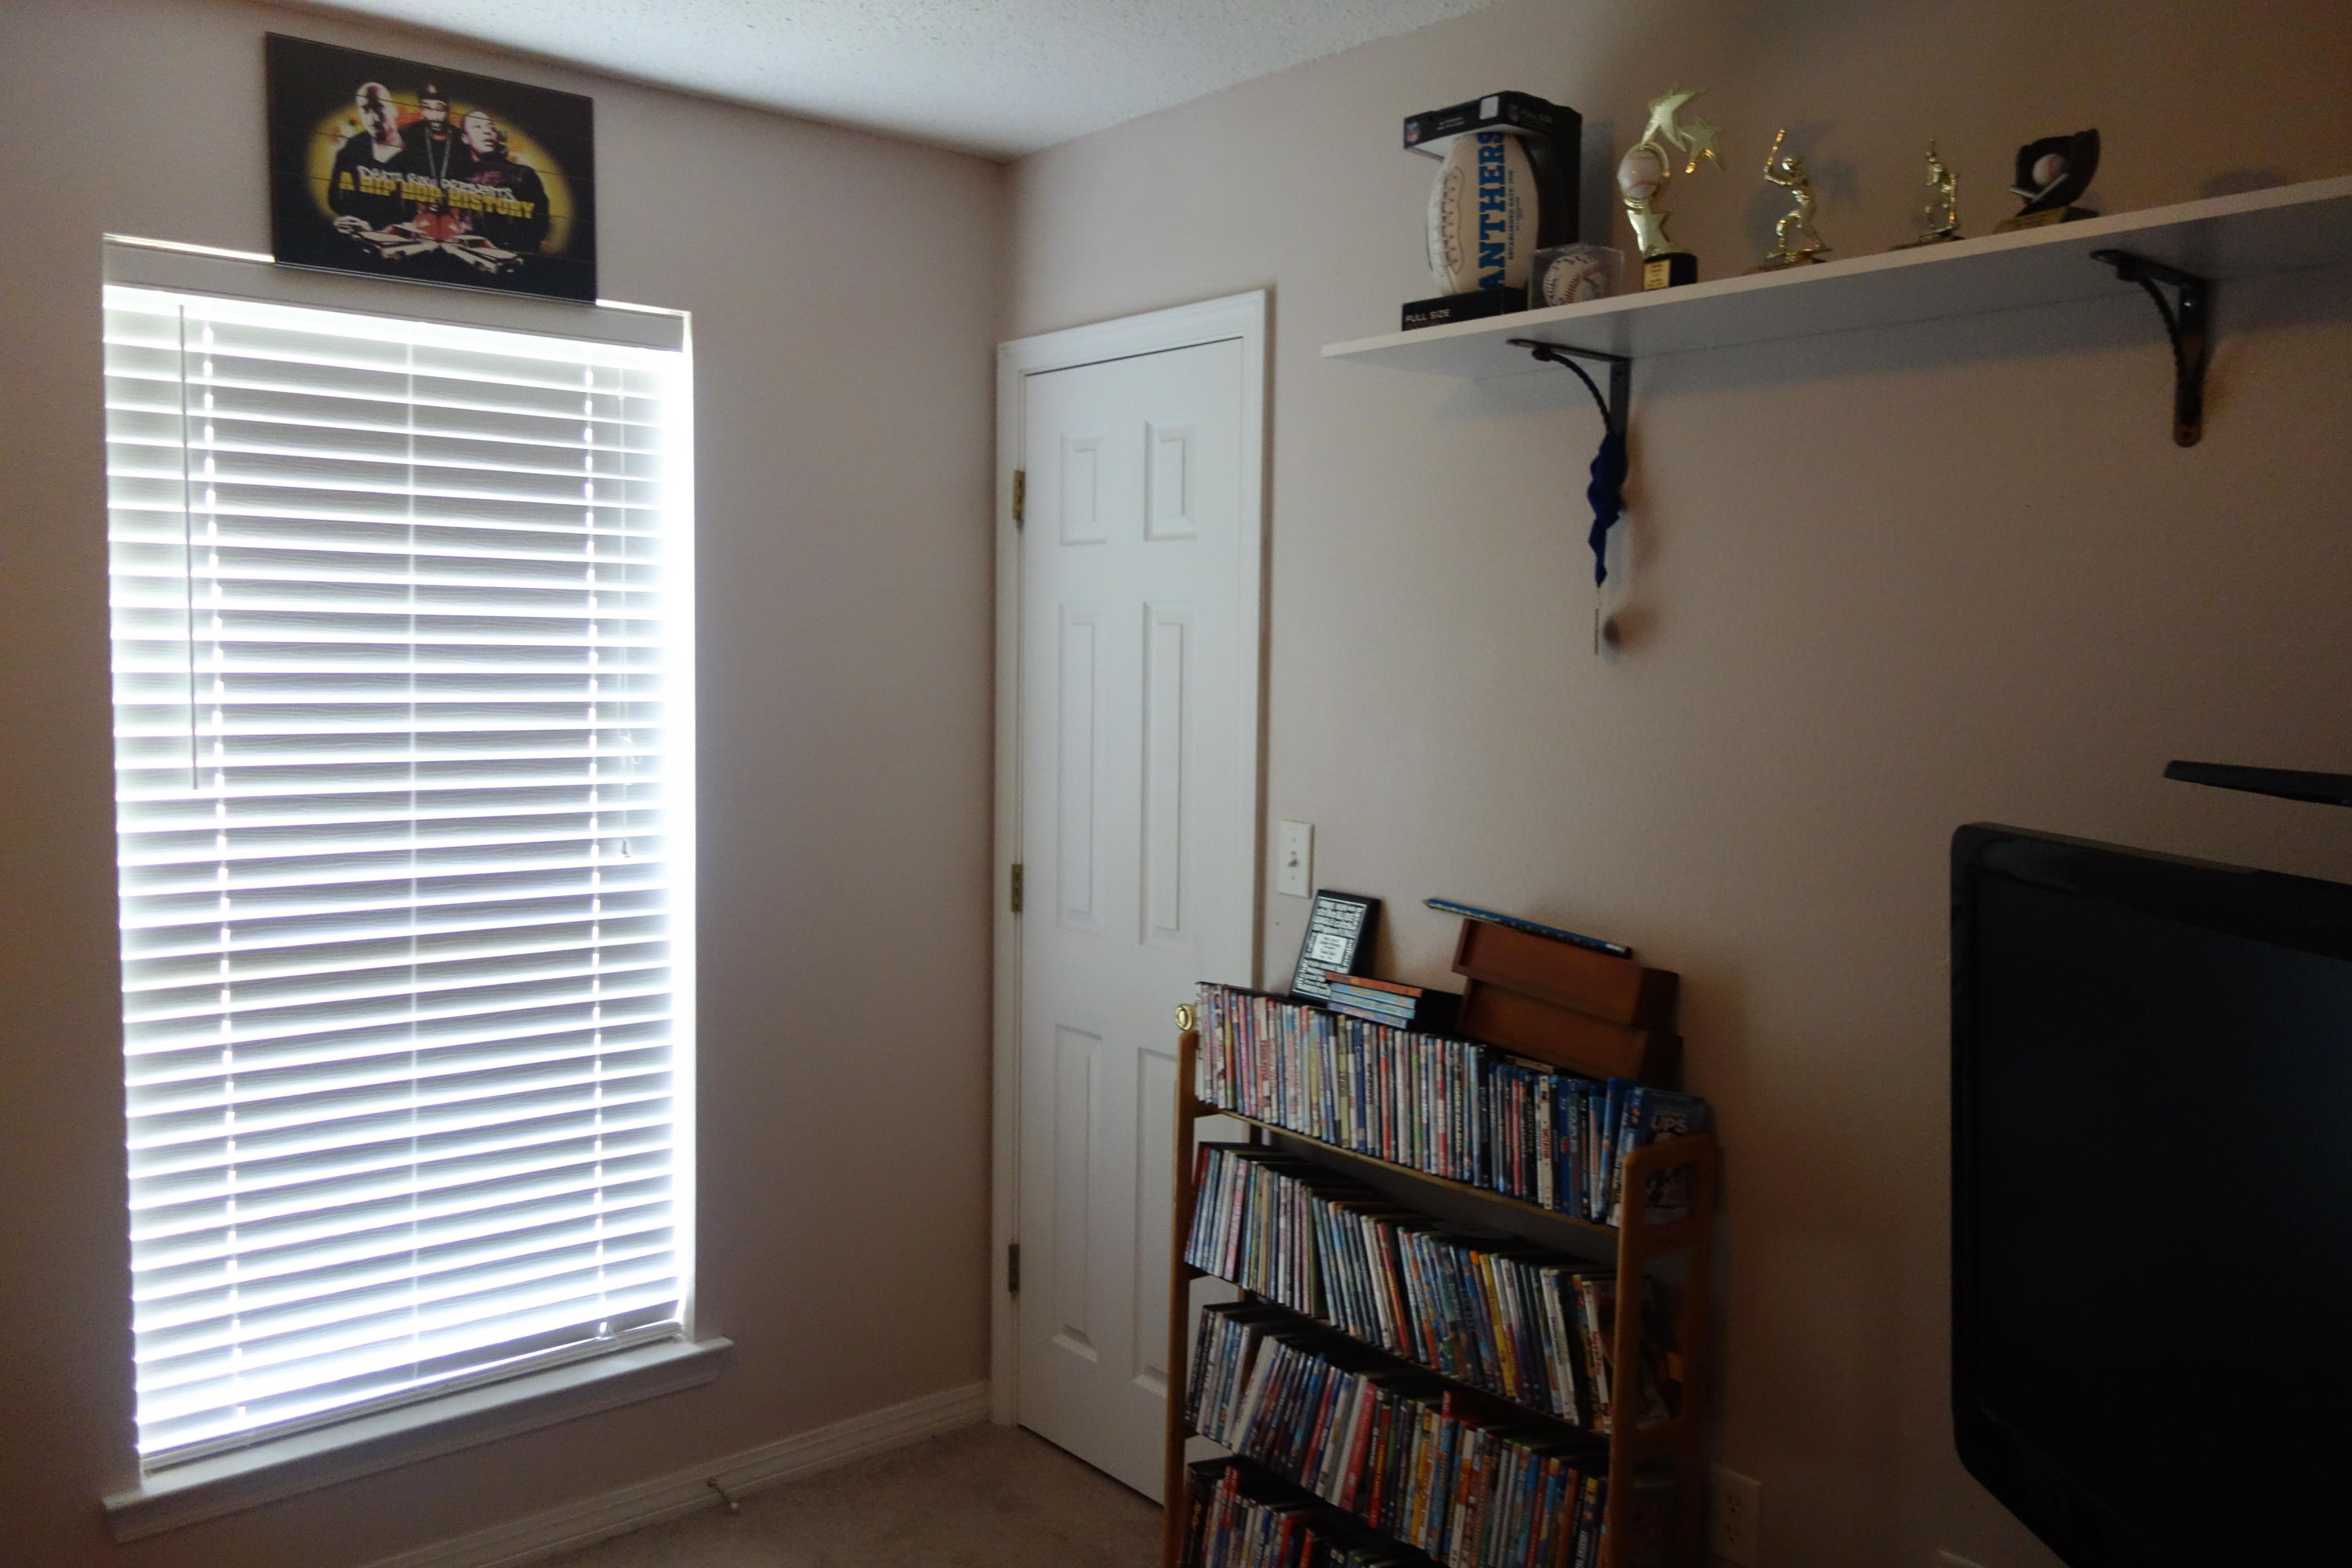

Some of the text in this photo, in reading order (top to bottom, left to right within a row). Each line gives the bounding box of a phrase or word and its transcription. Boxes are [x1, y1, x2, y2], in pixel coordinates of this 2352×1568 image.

[339, 171, 535, 220] A HIP HOP HISTORY
[1477, 132, 1505, 289] ANTHERS
[1405, 309, 1450, 323] FULL SIZE
